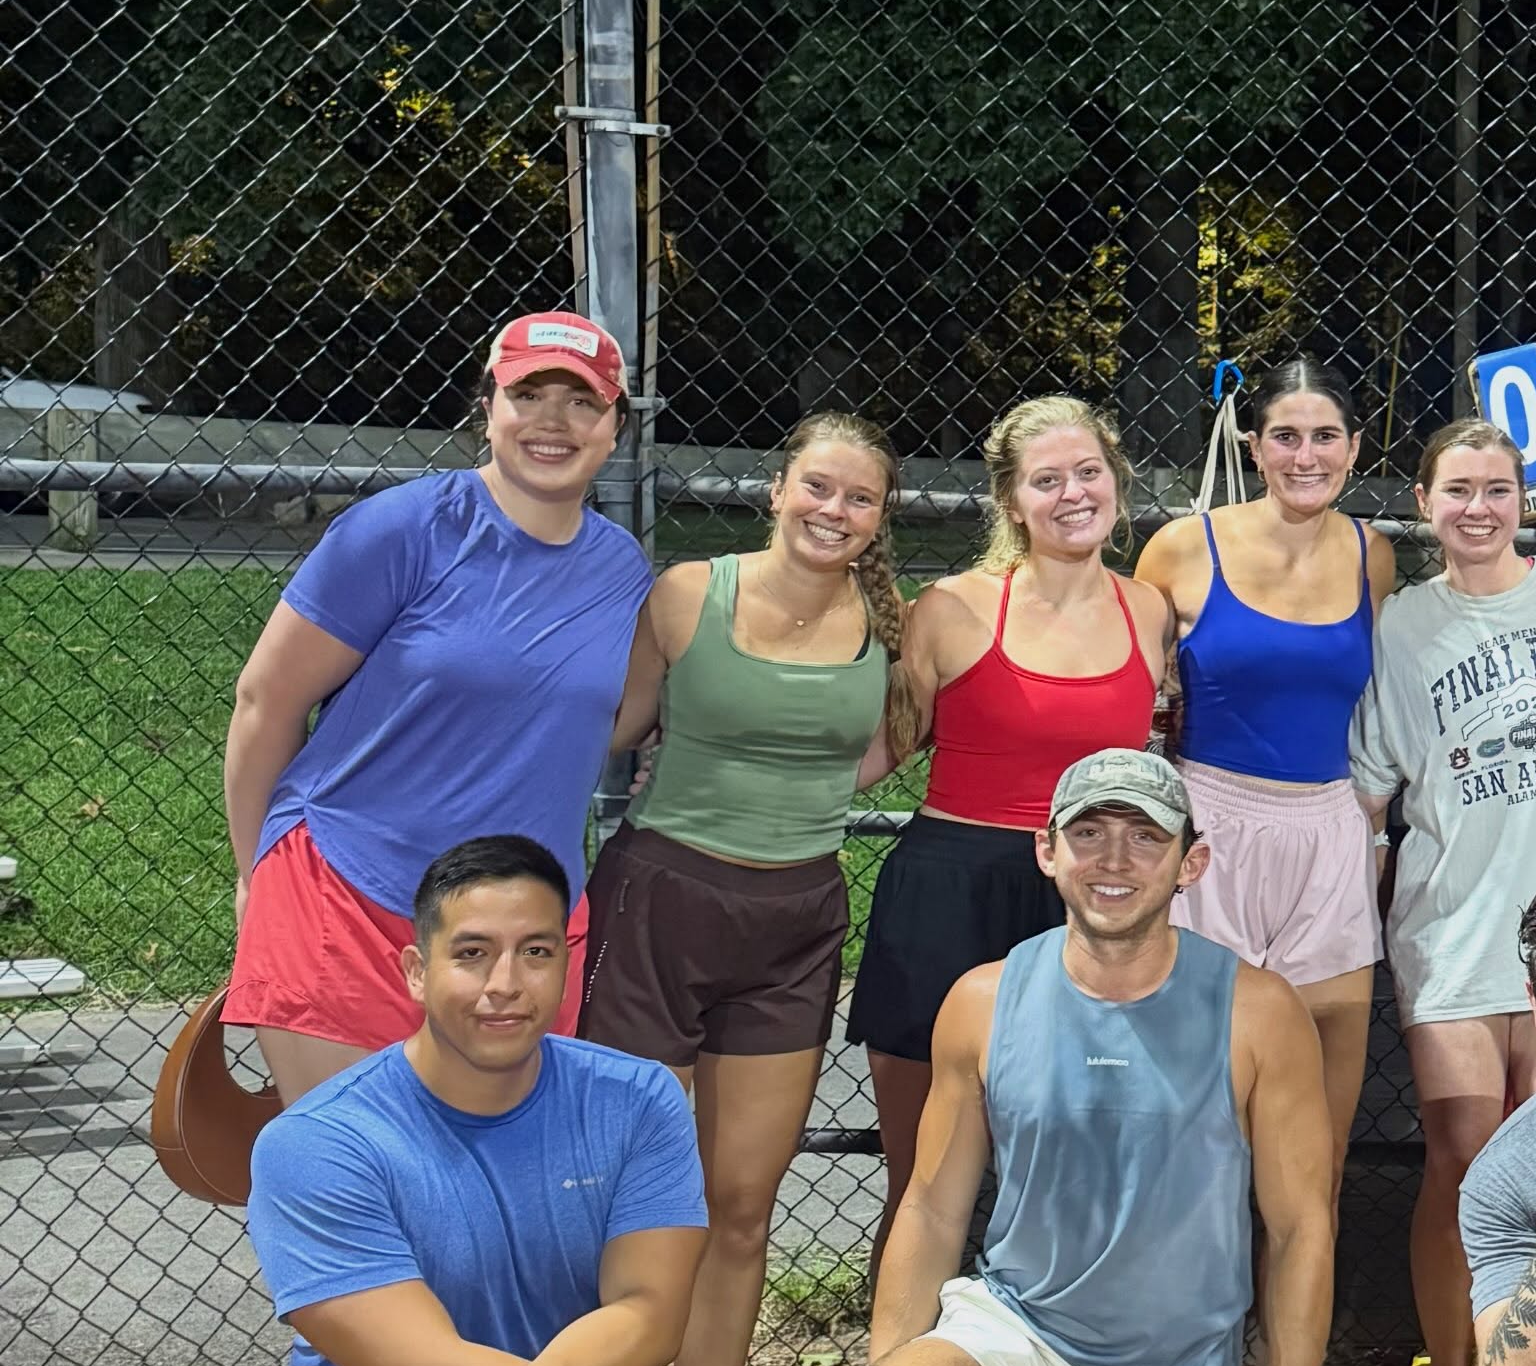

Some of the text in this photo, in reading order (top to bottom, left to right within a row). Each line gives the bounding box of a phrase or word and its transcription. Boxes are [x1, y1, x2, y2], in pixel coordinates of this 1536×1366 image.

[1431, 644, 1526, 737] FINAL
[1512, 727, 1536, 741] FINAL
[1462, 768, 1508, 806] SAN
